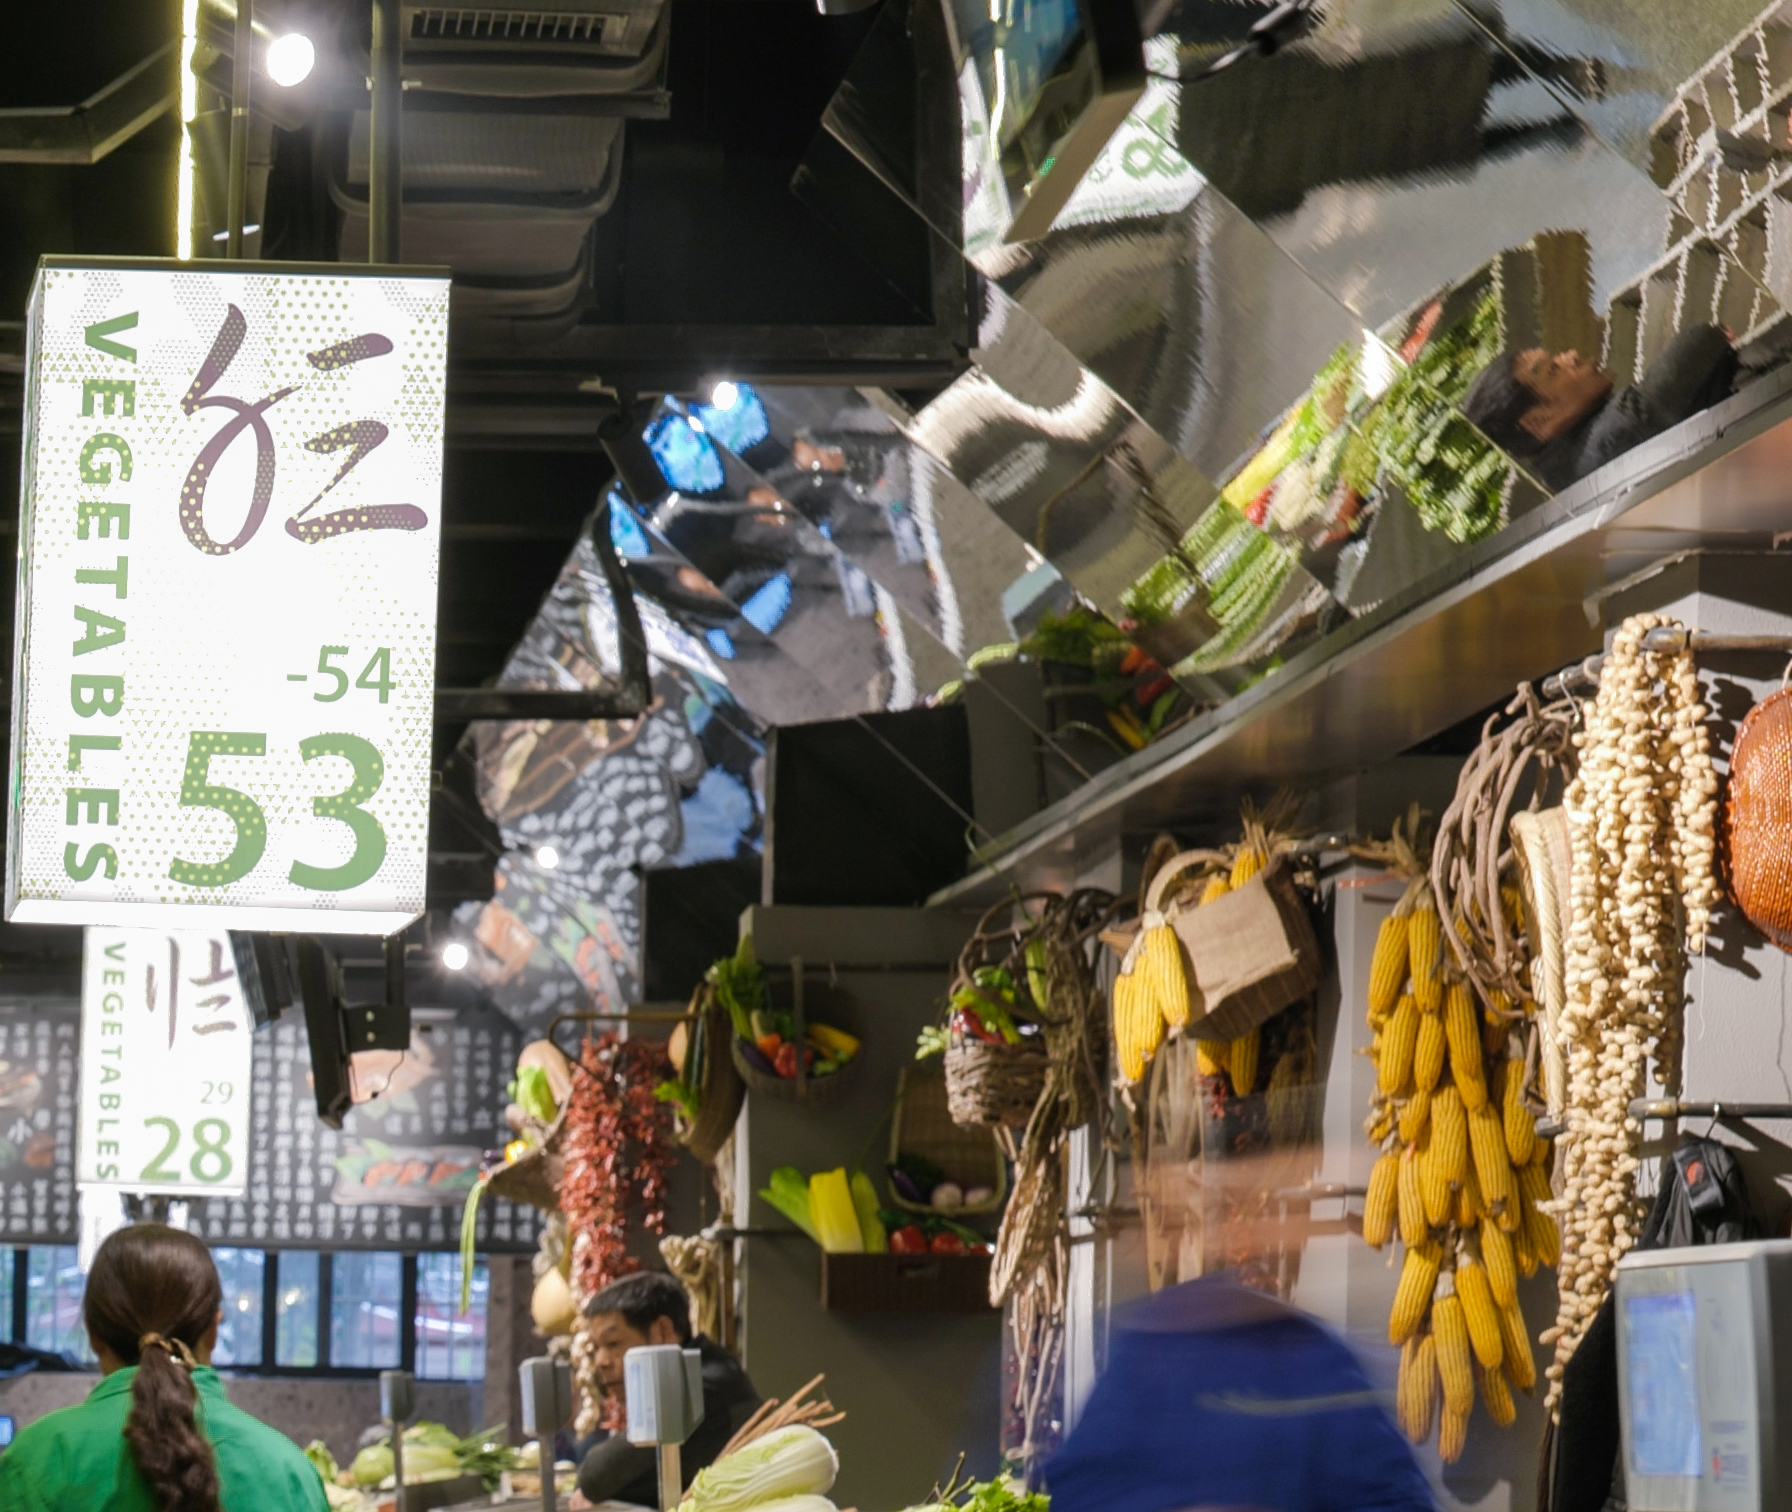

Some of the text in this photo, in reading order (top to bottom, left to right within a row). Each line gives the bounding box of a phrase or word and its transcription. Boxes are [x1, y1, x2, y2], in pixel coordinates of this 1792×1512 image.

[63, 310, 140, 883] VEGETABLES
[286, 644, 398, 705] -54
[167, 730, 389, 892] 53
[96, 941, 127, 1180] VEGETABLES
[199, 1080, 235, 1106] 29
[138, 1115, 234, 1183] 28
